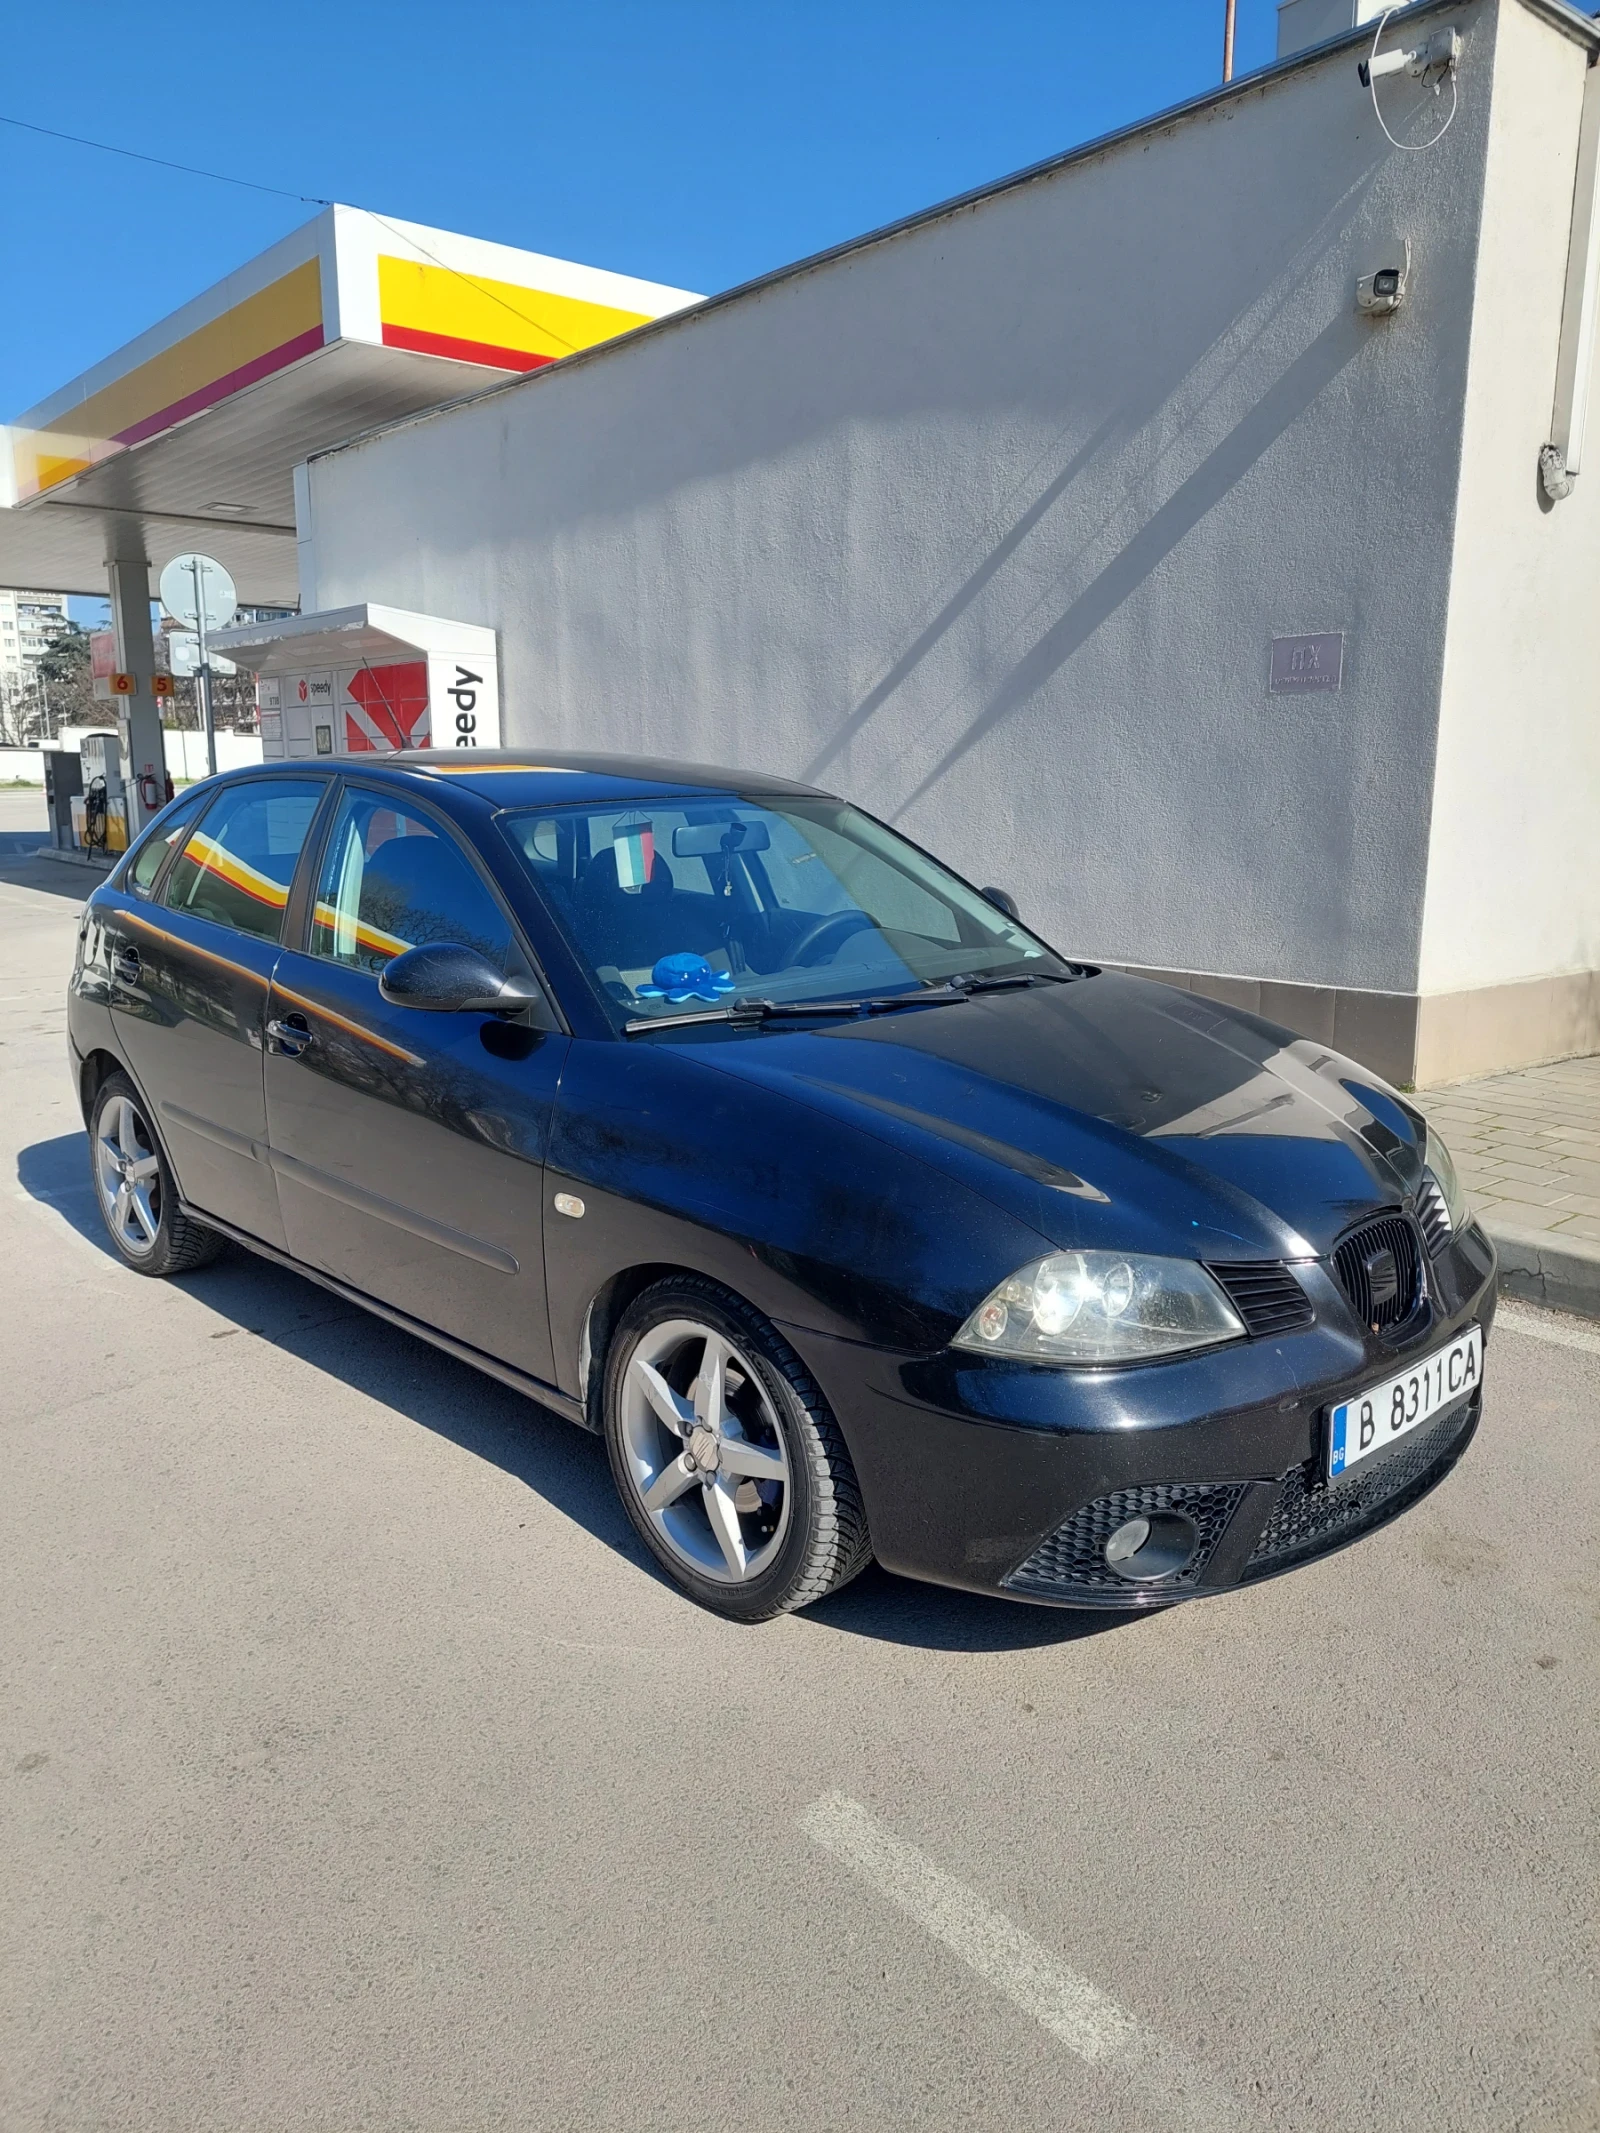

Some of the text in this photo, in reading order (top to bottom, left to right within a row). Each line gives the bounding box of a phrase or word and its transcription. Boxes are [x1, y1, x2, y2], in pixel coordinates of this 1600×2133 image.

[117, 676, 128, 690] 6
[156, 677, 167, 691] 5
[310, 680, 331, 696] speedy
[447, 665, 483, 748] eedy
[1359, 1400, 1375, 1451] B
[1333, 1447, 1345, 1465] BG
